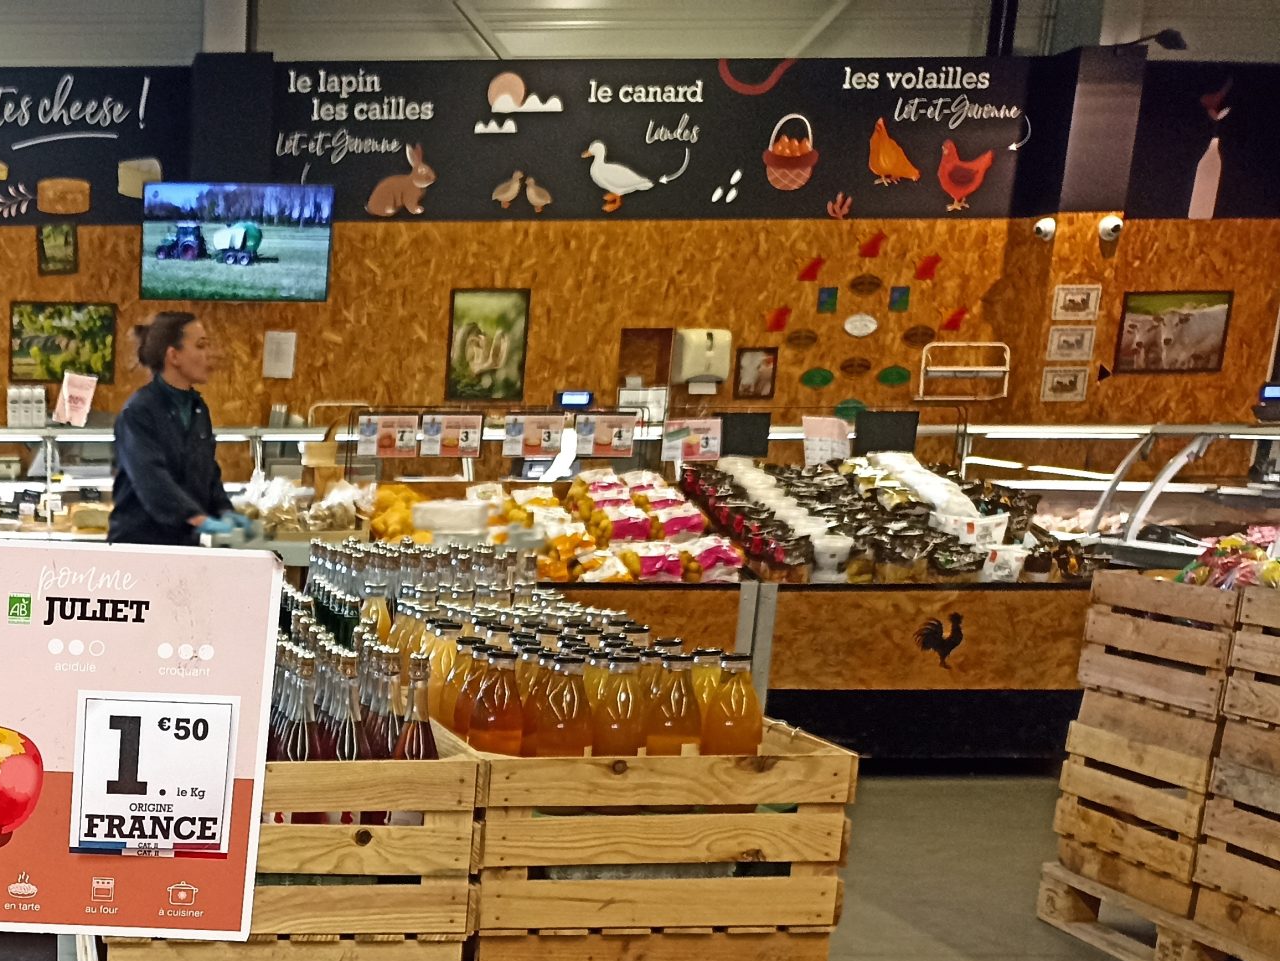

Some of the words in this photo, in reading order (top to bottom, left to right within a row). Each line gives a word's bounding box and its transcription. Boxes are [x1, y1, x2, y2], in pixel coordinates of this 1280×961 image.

[288, 69, 312, 93] le
[318, 68, 382, 98] lapin
[843, 66, 880, 89] les
[886, 66, 990, 89] volailles
[38, 73, 131, 128] cheese
[588, 79, 613, 103] le
[619, 79, 704, 103] canard
[311, 96, 349, 121] les
[354, 95, 435, 121] cailles
[37, 565, 137, 600] pomme
[43, 596, 150, 625] JULIET
[158, 665, 211, 678] croquant
[177, 787, 187, 797] le
[190, 787, 206, 800] Kg
[129, 803, 174, 813] ORIGINE
[84, 814, 218, 840] FRANCE
[4, 902, 16, 910] en
[18, 901, 41, 911] tarte
[85, 905, 97, 913] au
[99, 905, 119, 914] four
[158, 907, 165, 917] à
[166, 908, 204, 918] cuisiner
